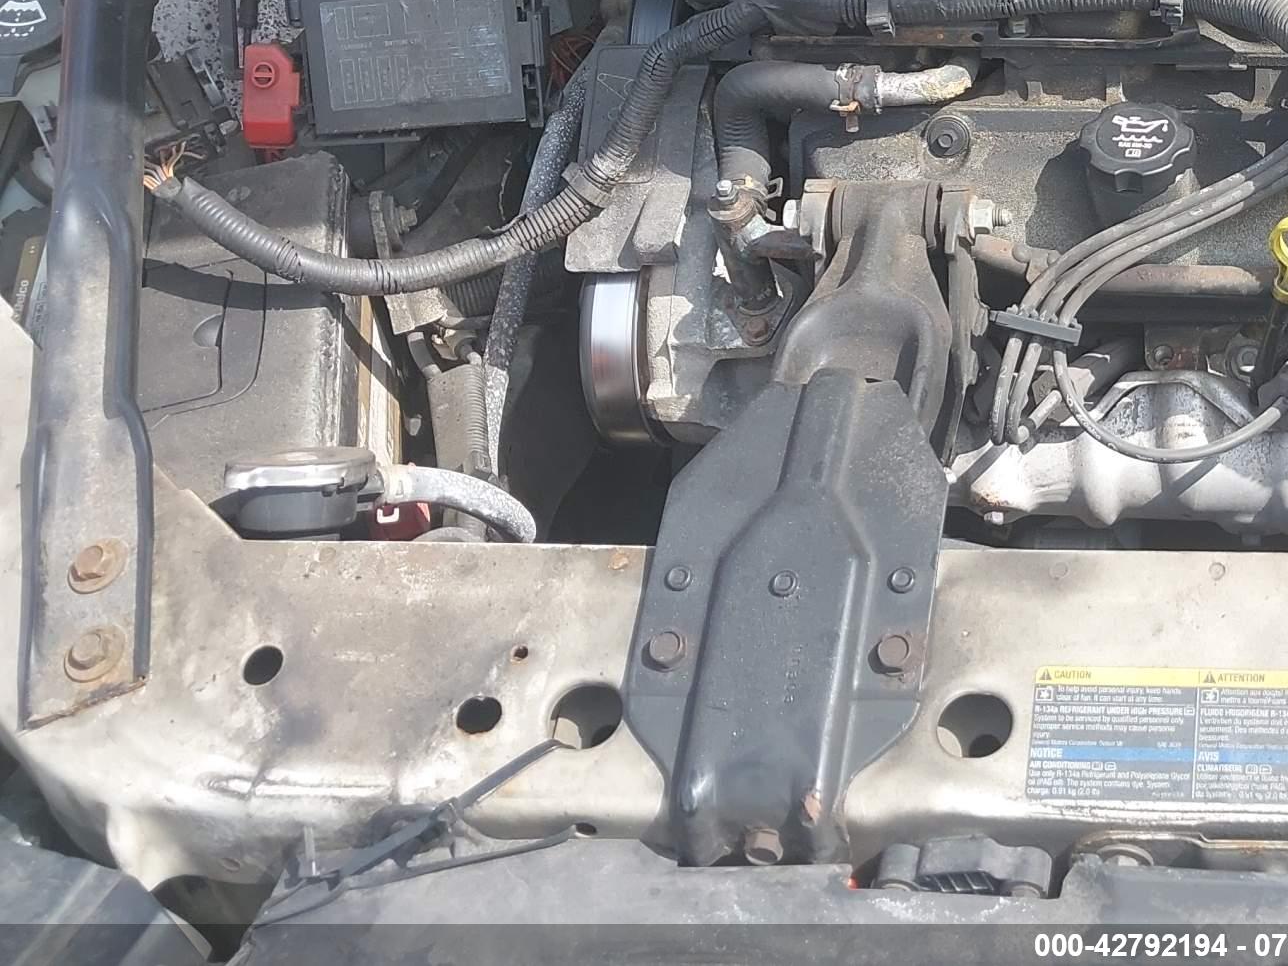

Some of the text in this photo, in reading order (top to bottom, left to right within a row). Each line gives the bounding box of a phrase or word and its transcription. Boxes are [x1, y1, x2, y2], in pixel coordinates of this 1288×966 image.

[1054, 671, 1091, 679] CAUTION
[1218, 674, 1265, 682] ATTENTION
[1060, 706, 1105, 714] REFRIGERANT
[1107, 706, 1129, 714] UNDER
[1149, 707, 1183, 715] PRESSURE
[1030, 748, 1063, 758] NOTICE
[1198, 751, 1219, 761] AVIS
[1043, 761, 1091, 769] CONDITIONING
[1066, 778, 1079, 786] The
